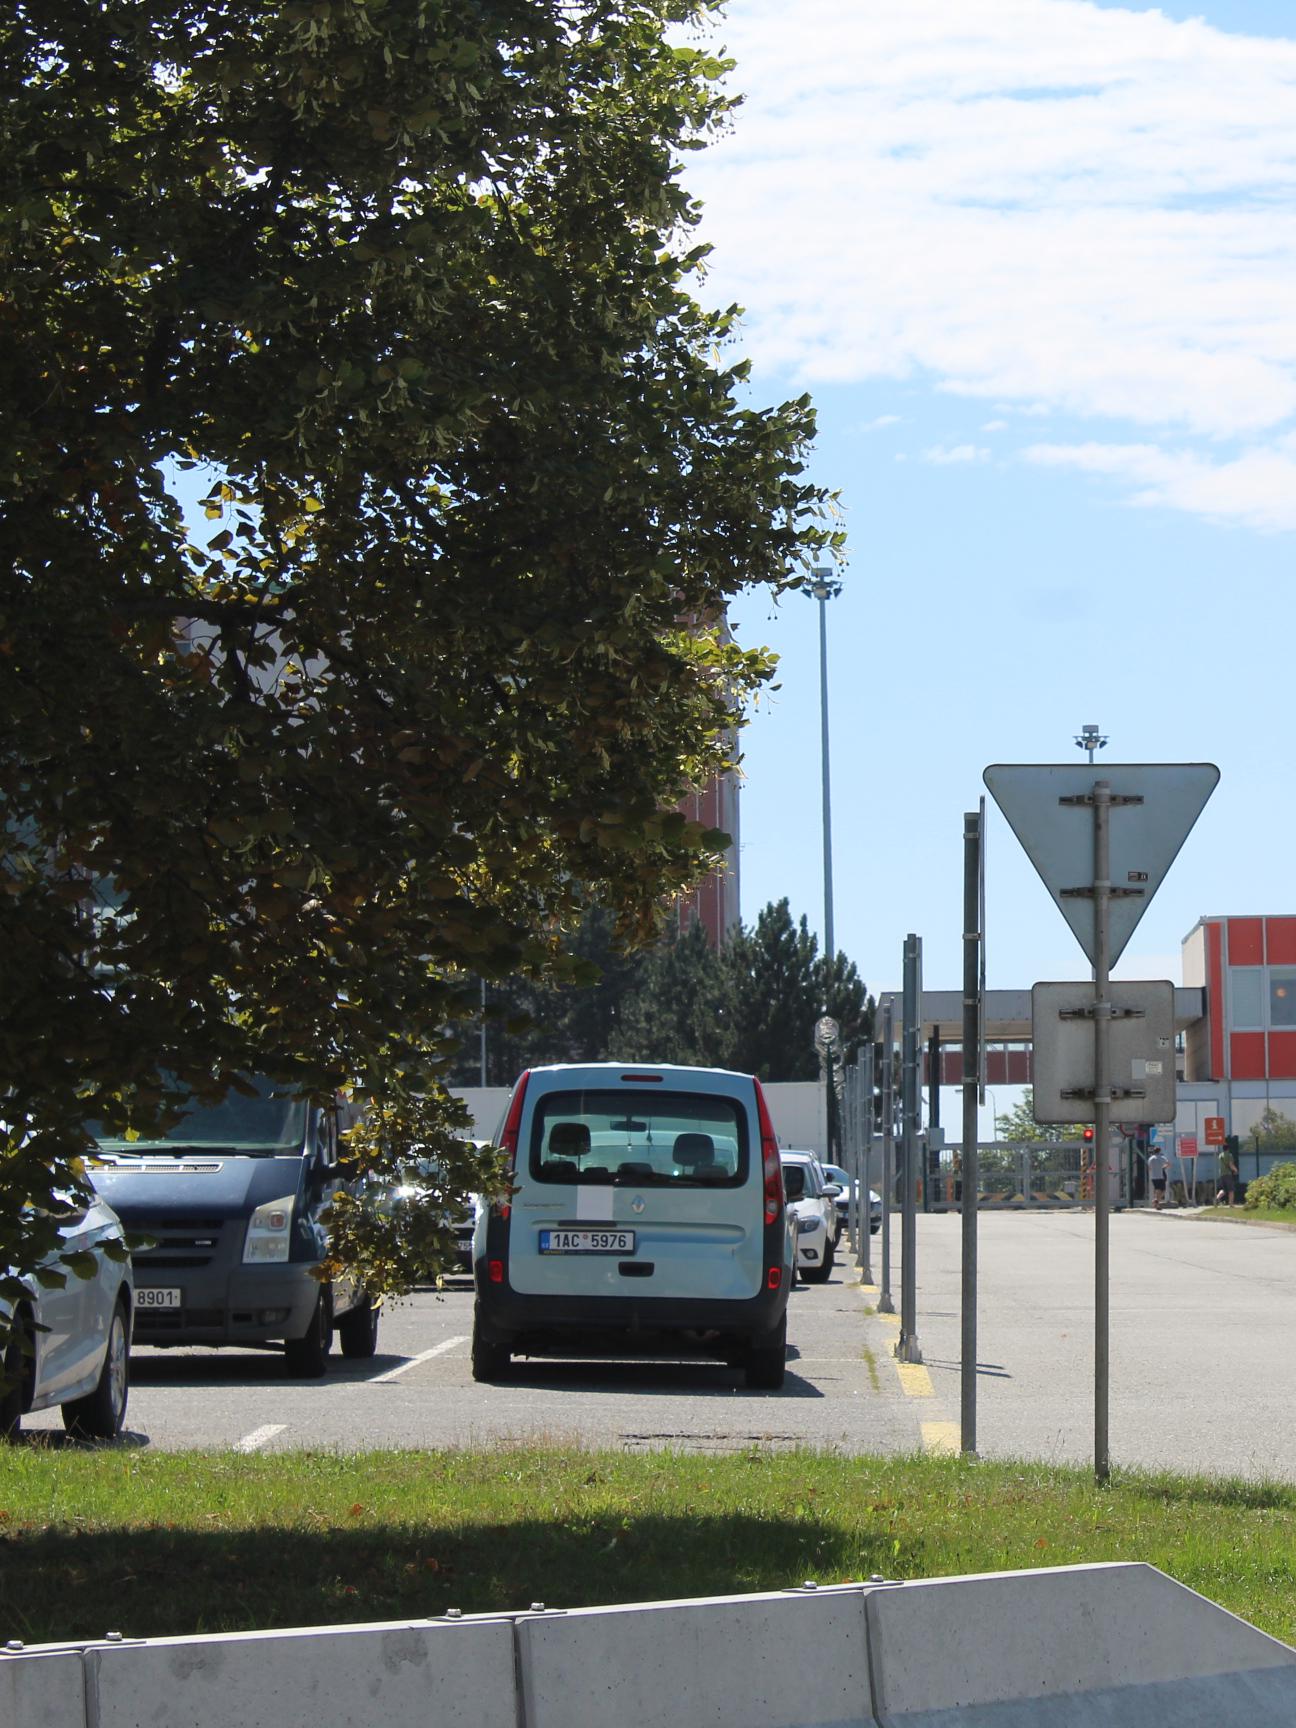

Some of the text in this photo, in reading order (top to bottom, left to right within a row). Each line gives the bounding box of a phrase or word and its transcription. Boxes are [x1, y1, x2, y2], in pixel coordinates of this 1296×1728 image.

[554, 1234, 627, 1248] 1AC 5976
[137, 1291, 173, 1305] 8901
